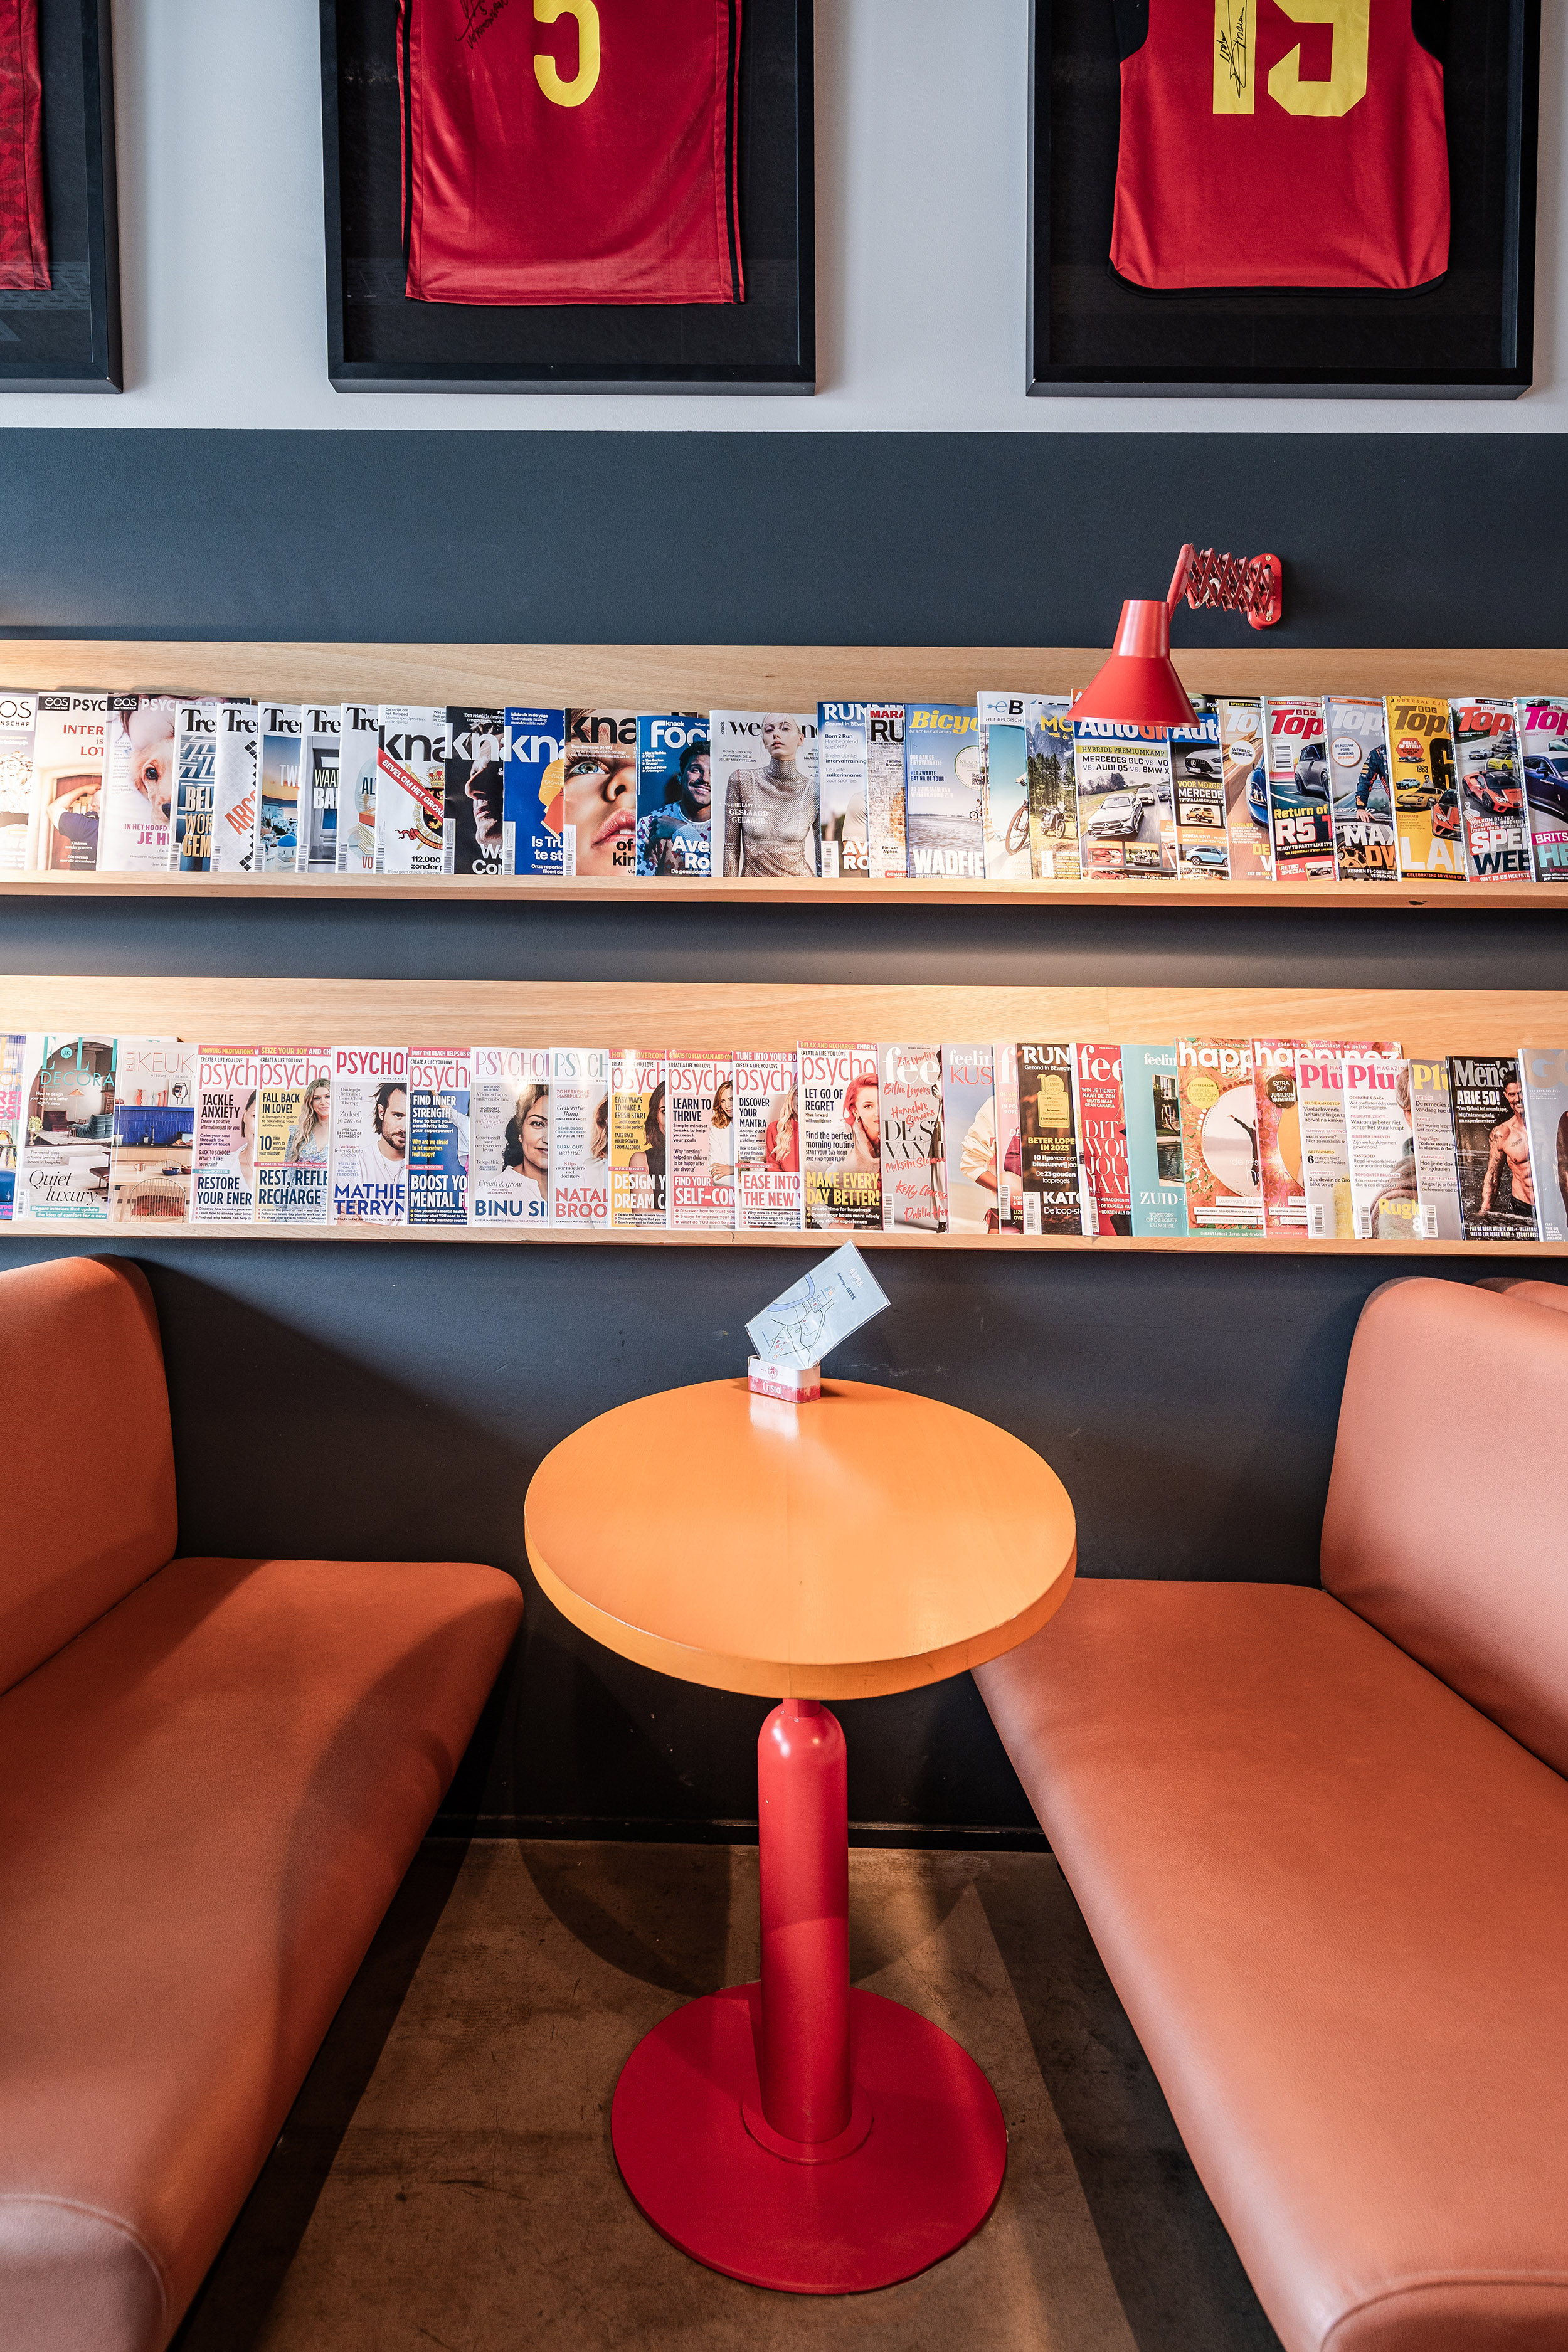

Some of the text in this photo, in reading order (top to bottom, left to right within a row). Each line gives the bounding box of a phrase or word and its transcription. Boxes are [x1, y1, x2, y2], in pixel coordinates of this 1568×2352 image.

[45, 697, 68, 707] eos
[114, 697, 137, 707] eos
[63, 724, 104, 735] INTER
[1271, 709, 1324, 739] Top
[1113, 747, 1165, 757] PREMIUMKAMP
[1083, 756, 1126, 764] MERCEDES
[381, 758, 425, 800] BEVEL OM HET
[1273, 803, 1328, 819] Return of
[1274, 815, 1316, 847] R5
[137, 832, 152, 845] JE
[532, 835, 543, 847] Is
[616, 838, 633, 851] of
[534, 849, 548, 861] te
[805, 1088, 843, 1099] LET GO OF
[884, 1081, 905, 1095] Billie
[203, 1094, 233, 1106] TACKLE
[263, 1093, 300, 1103] FALL BACK
[414, 1095, 456, 1106] FIND INNER
[673, 1098, 711, 1110] LEARN TO
[739, 1098, 770, 1107] DISCOVER
[1457, 1090, 1501, 1106] ARIE 50!
[202, 1106, 240, 1118] ANXIETY
[263, 1104, 292, 1114] IN LOVE!
[413, 1107, 452, 1118] STRENGTH
[805, 1101, 834, 1111] REGRET
[673, 1110, 702, 1122] THRIVE
[739, 1108, 757, 1118] YOUR
[739, 1118, 766, 1128] MANTRA
[1084, 1120, 1119, 1138] DIT
[260, 1135, 272, 1150] 10
[1027, 1136, 1054, 1145] BETER
[29, 1170, 73, 1189] Quiet
[198, 1177, 240, 1190] RESTORE
[260, 1170, 290, 1189] REST,
[411, 1175, 448, 1190] BOOST
[479, 1180, 498, 1188] Crash
[507, 1181, 522, 1189] grow
[615, 1174, 654, 1190] DESIGN
[807, 1172, 878, 1189] MAKE EVERY
[46, 1187, 98, 1206] luxury
[259, 1189, 320, 1204] RECHARGE
[334, 1184, 405, 1199] MATHIE
[807, 1189, 880, 1206] DAY BETTER!
[198, 1192, 225, 1205] YOUR
[411, 1192, 455, 1207] MENTAL
[614, 1194, 655, 1209] DREAM
[334, 1200, 405, 1216] TERRYN
[475, 1200, 522, 1217] BINU
[845, 1286, 856, 1301] BEERS
[762, 1381, 783, 1395] Cristal
